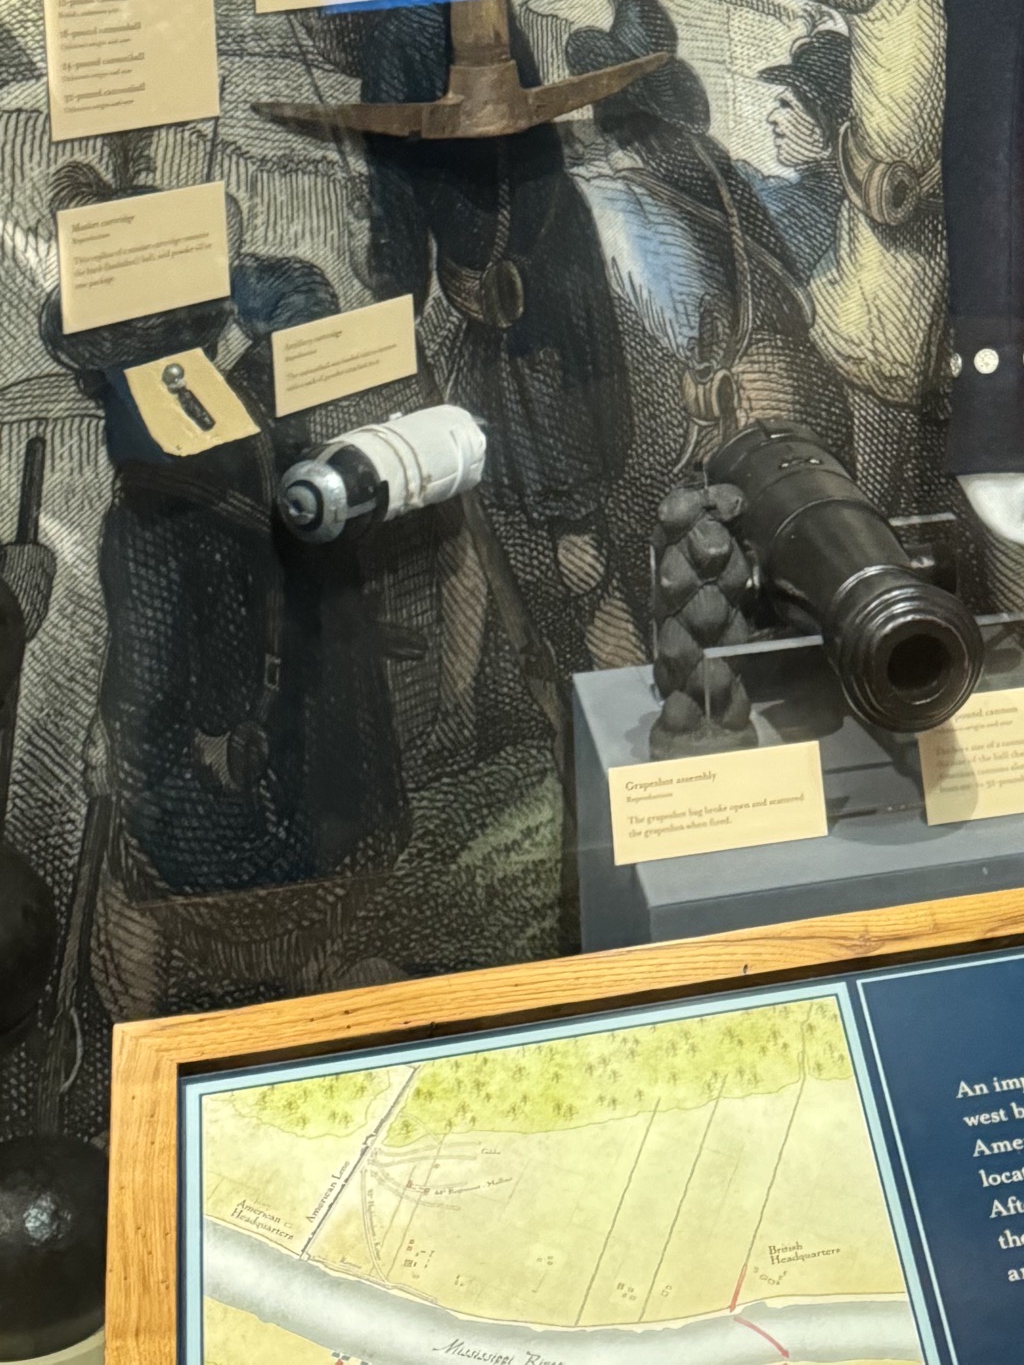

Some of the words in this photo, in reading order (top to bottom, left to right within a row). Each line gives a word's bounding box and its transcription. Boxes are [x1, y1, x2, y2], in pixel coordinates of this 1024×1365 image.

[957, 1081, 989, 1098] An
[963, 1108, 1008, 1127] west
[236, 1199, 281, 1223] American
[230, 1207, 294, 1240] Headquarters
[768, 1241, 803, 1255] British
[770, 1248, 840, 1265] Headquarters
